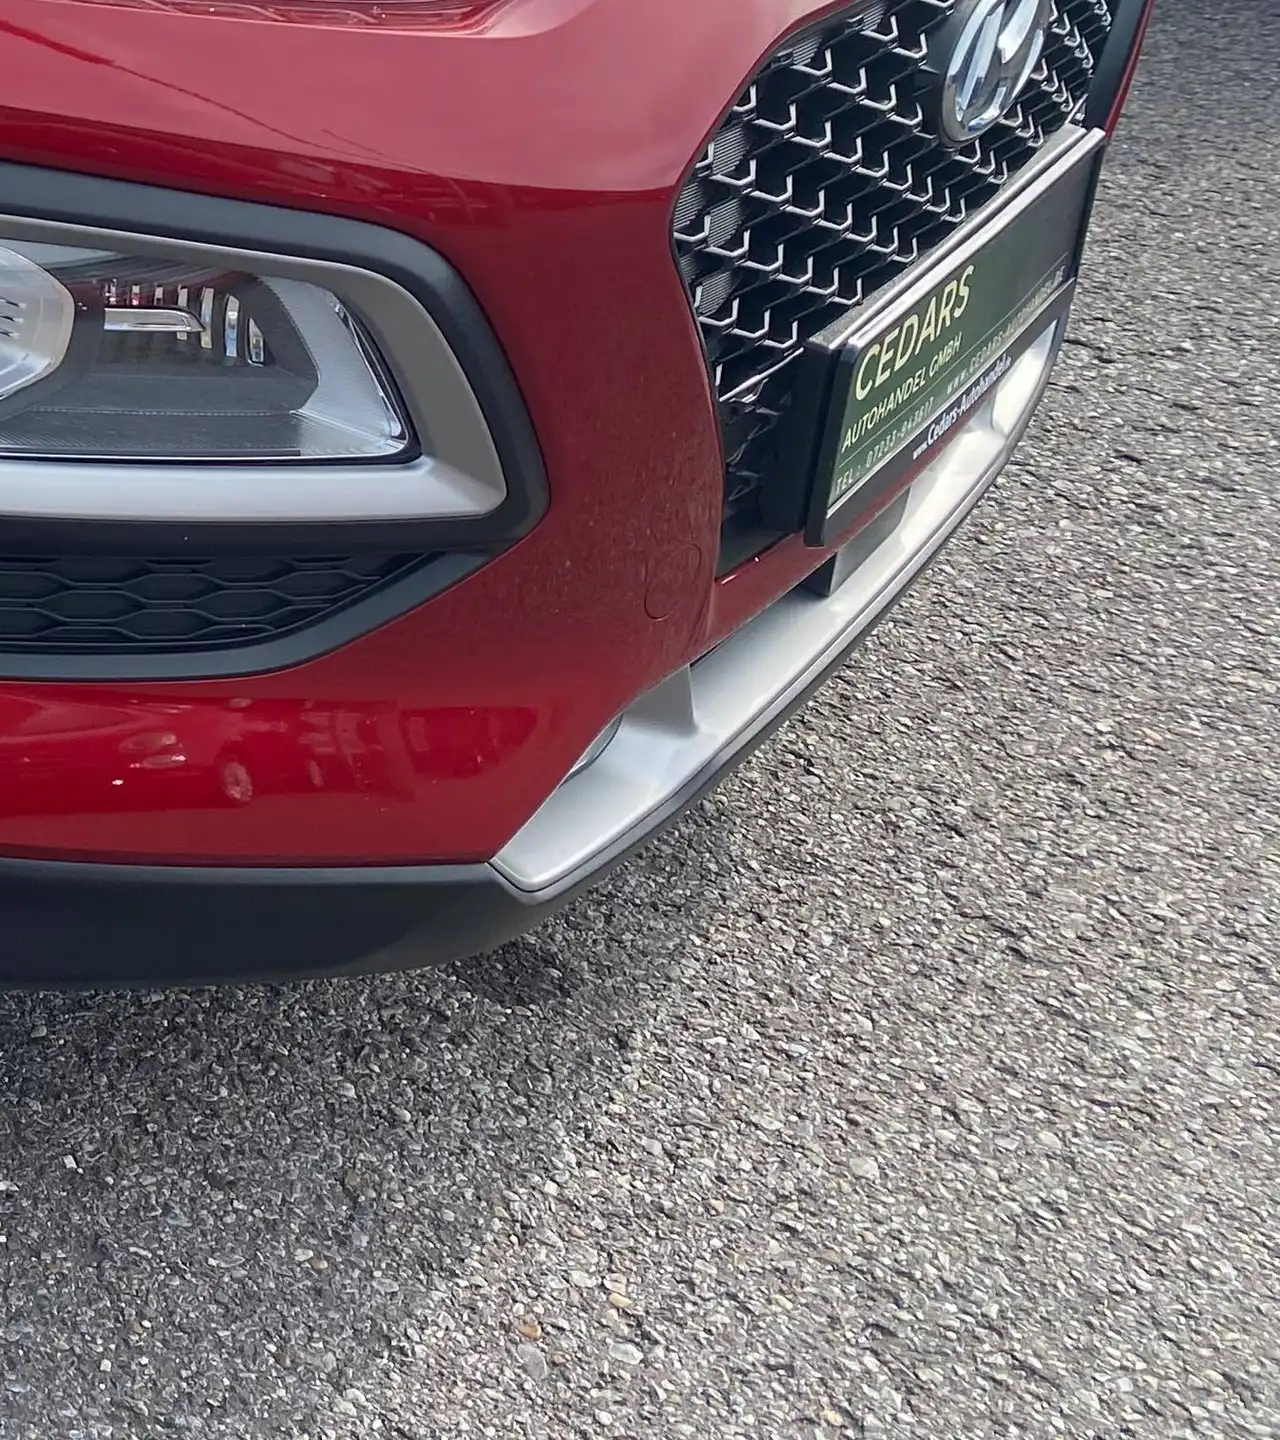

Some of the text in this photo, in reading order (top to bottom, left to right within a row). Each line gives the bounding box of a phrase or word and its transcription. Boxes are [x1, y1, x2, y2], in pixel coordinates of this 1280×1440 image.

[841, 331, 963, 454] AUTOHANDEL GMBH
[855, 264, 975, 401] CEDARS
